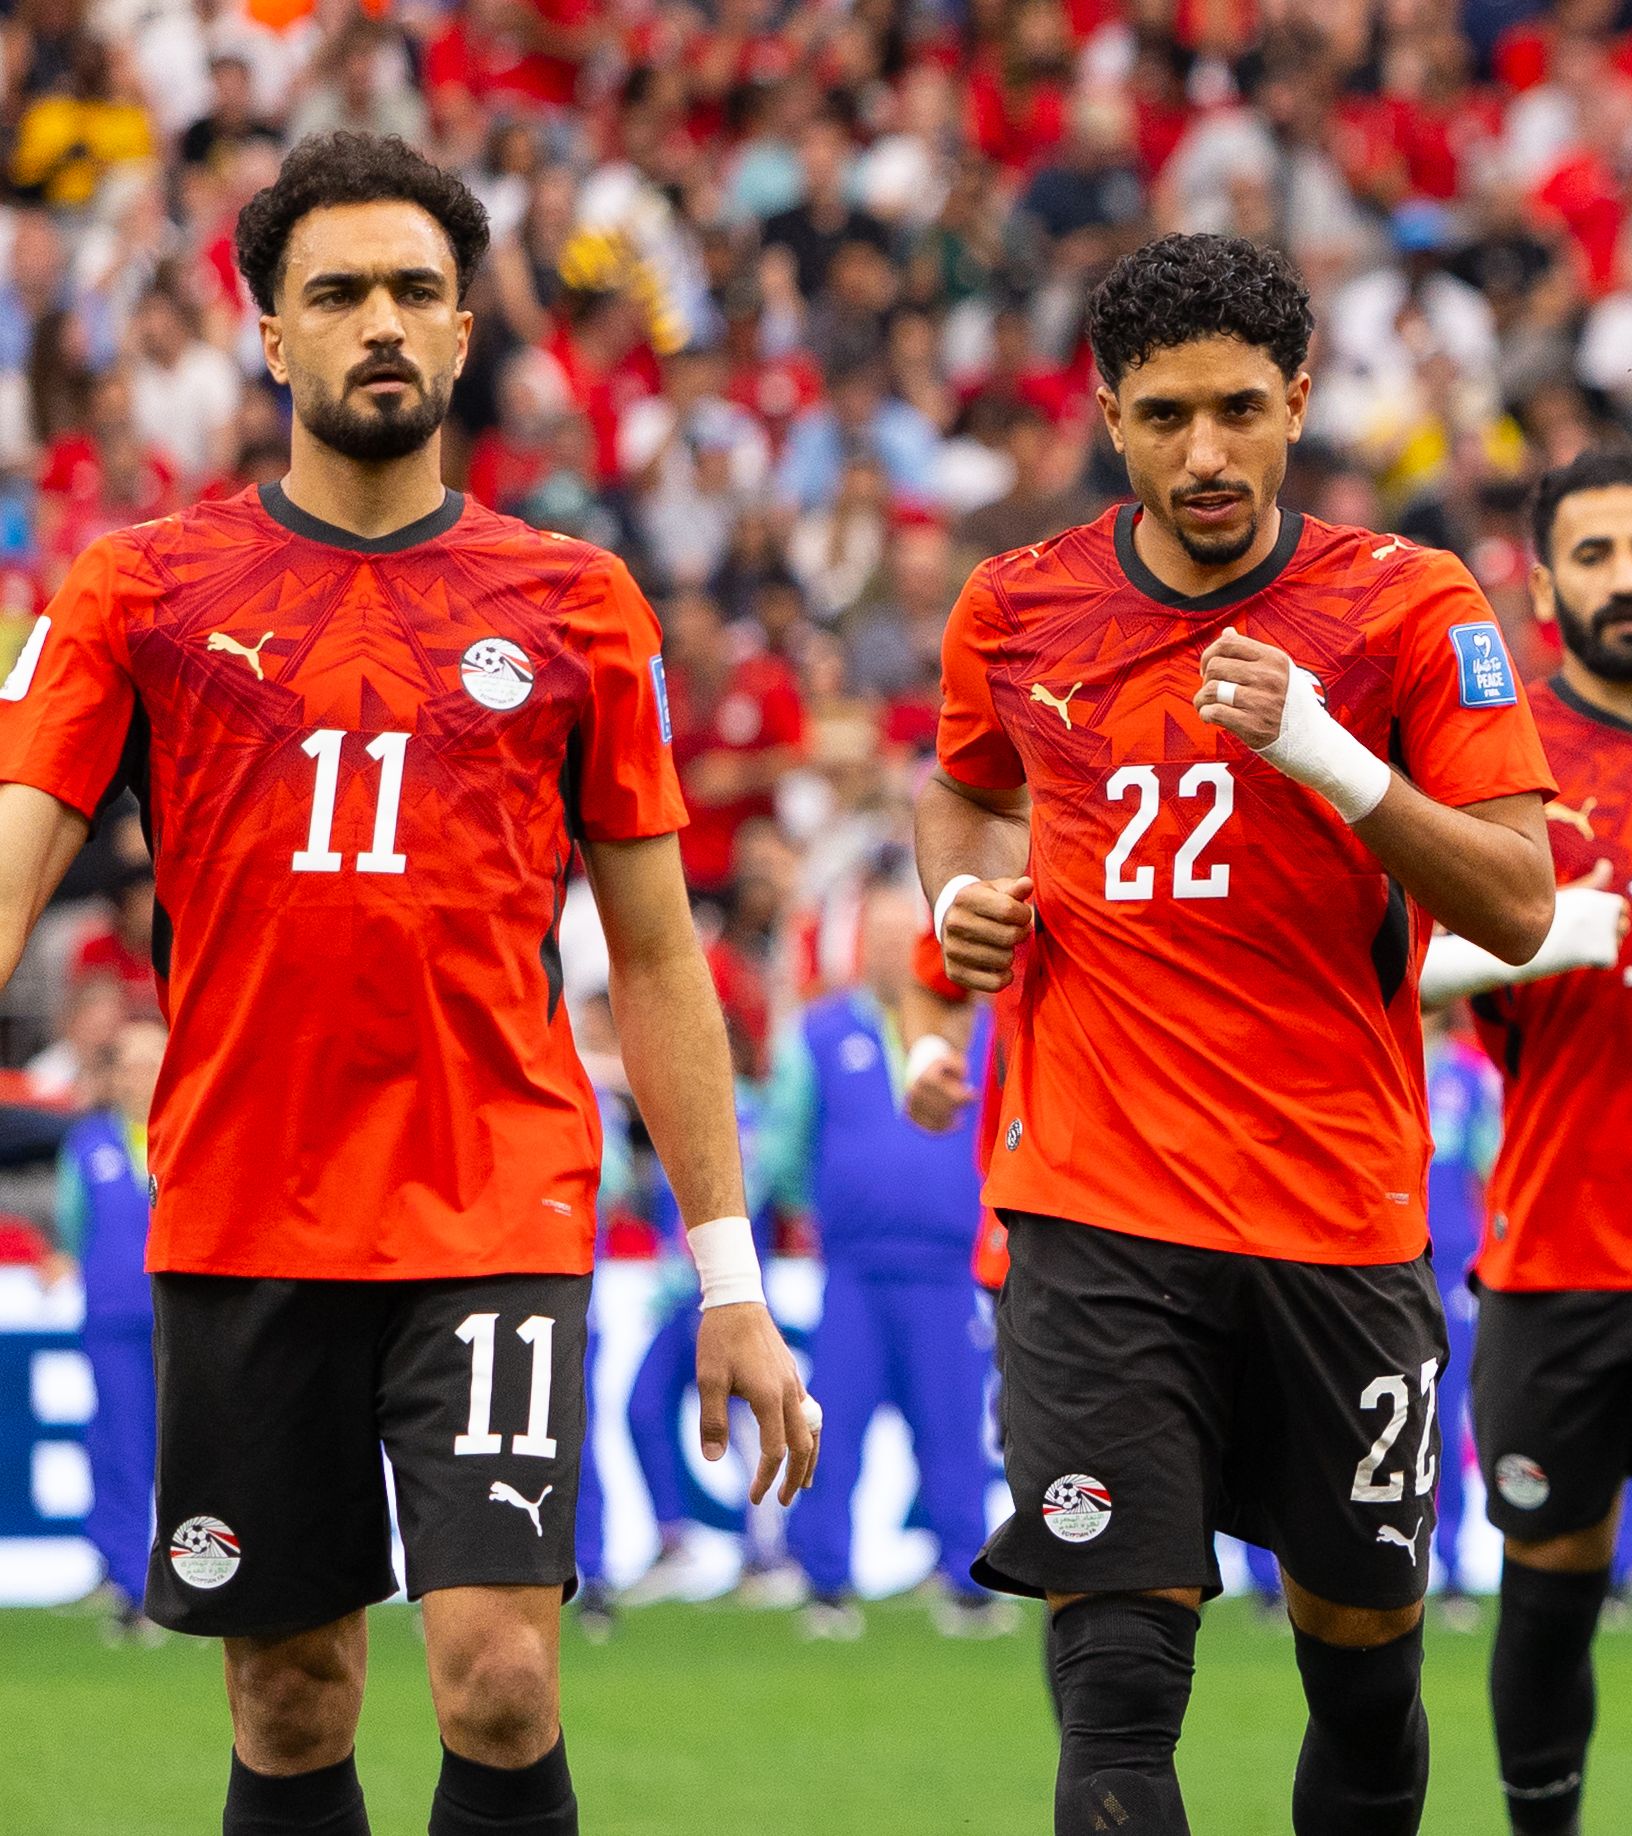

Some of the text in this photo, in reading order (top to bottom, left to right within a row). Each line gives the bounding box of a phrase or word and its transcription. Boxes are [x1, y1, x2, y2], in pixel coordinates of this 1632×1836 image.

[1476, 672, 1505, 689] PEACE
[291, 728, 412, 874] 11
[1104, 762, 1235, 901] 22
[453, 1312, 558, 1459] 11
[1350, 1356, 1439, 1503] 22
